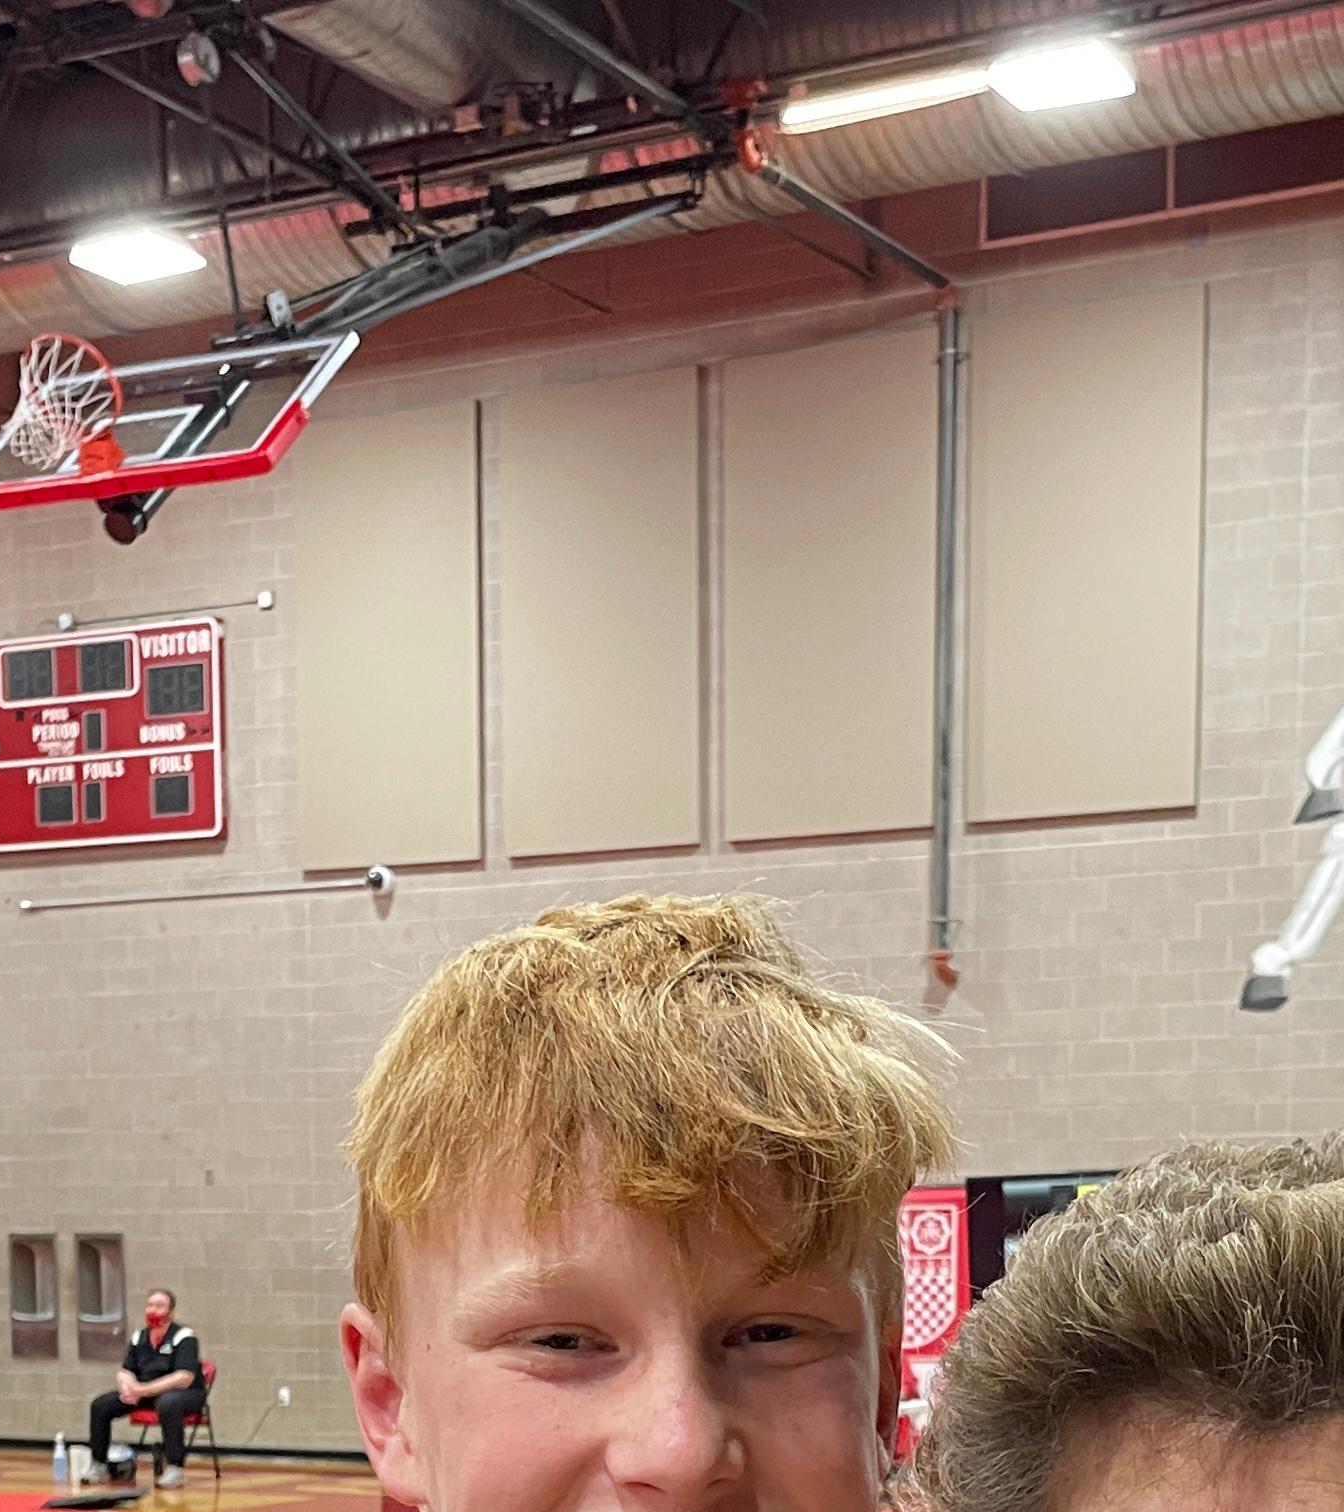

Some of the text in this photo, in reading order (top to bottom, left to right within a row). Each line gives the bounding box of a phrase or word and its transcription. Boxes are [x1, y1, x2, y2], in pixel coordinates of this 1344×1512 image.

[140, 629, 211, 659] VISITOR
[32, 721, 80, 743] PERIOD
[139, 722, 186, 744] BONUS
[27, 759, 125, 785] PLAYER FOULS
[149, 754, 194, 775] FOULS
